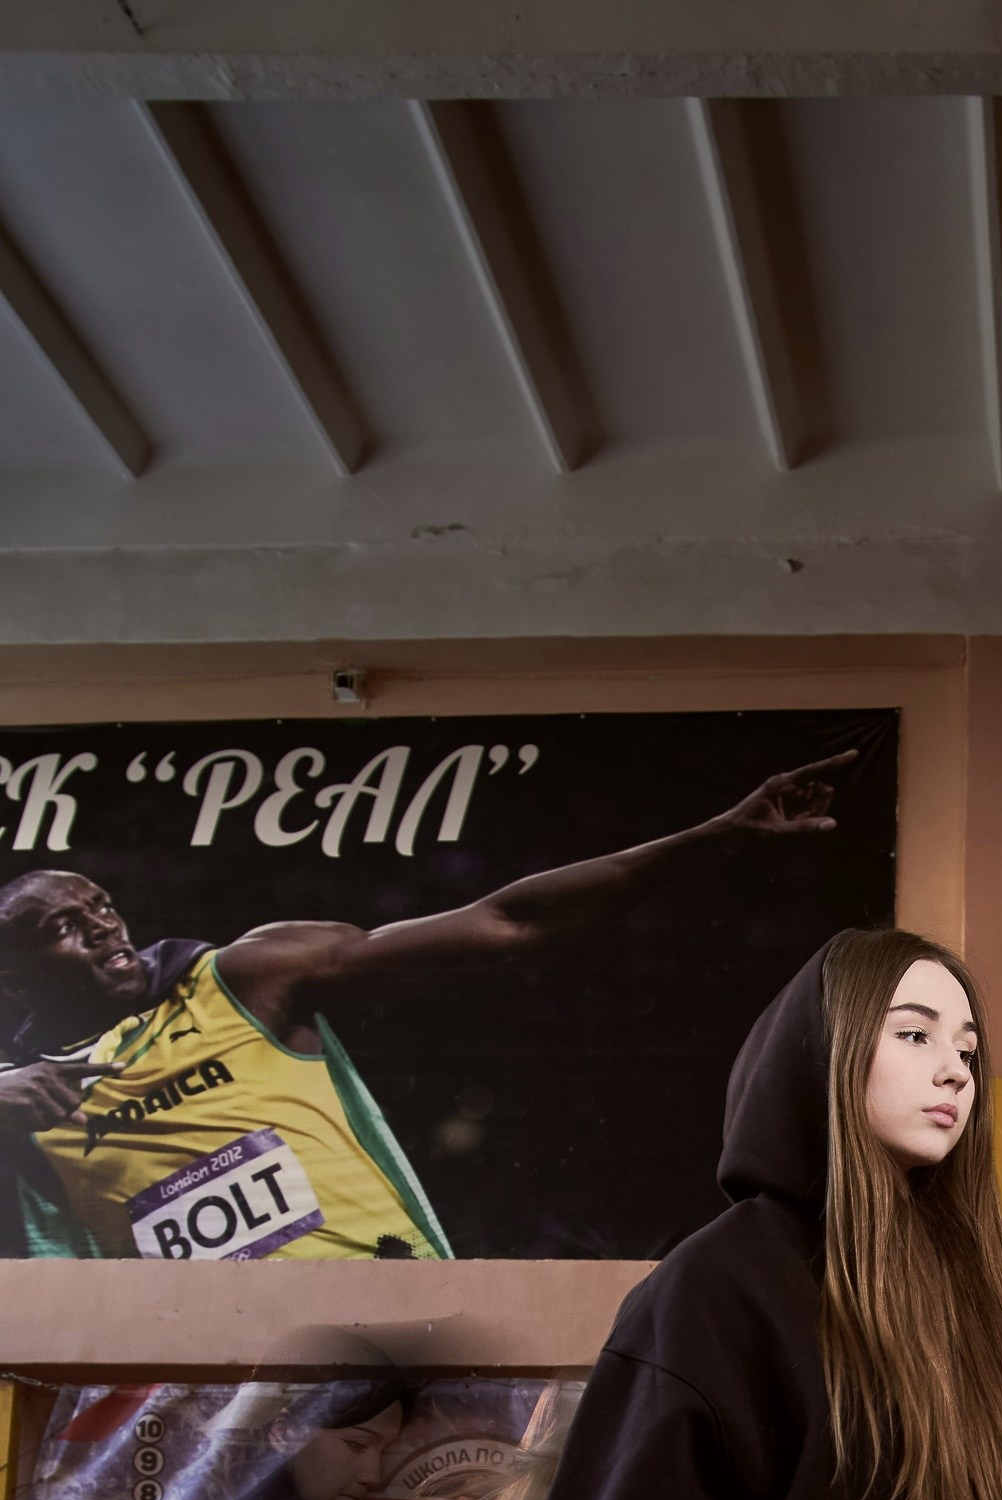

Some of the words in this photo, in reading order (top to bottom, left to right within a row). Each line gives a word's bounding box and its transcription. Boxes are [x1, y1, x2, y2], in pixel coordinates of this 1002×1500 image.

[160, 1165, 210, 1199] London
[210, 1146, 244, 1171] 2012
[152, 1161, 291, 1259] BOLT
[136, 1420, 162, 1438] 10
[140, 1451, 157, 1472] 9
[403, 1448, 471, 1490] ШКОЛА
[475, 1448, 504, 1465] ПО
